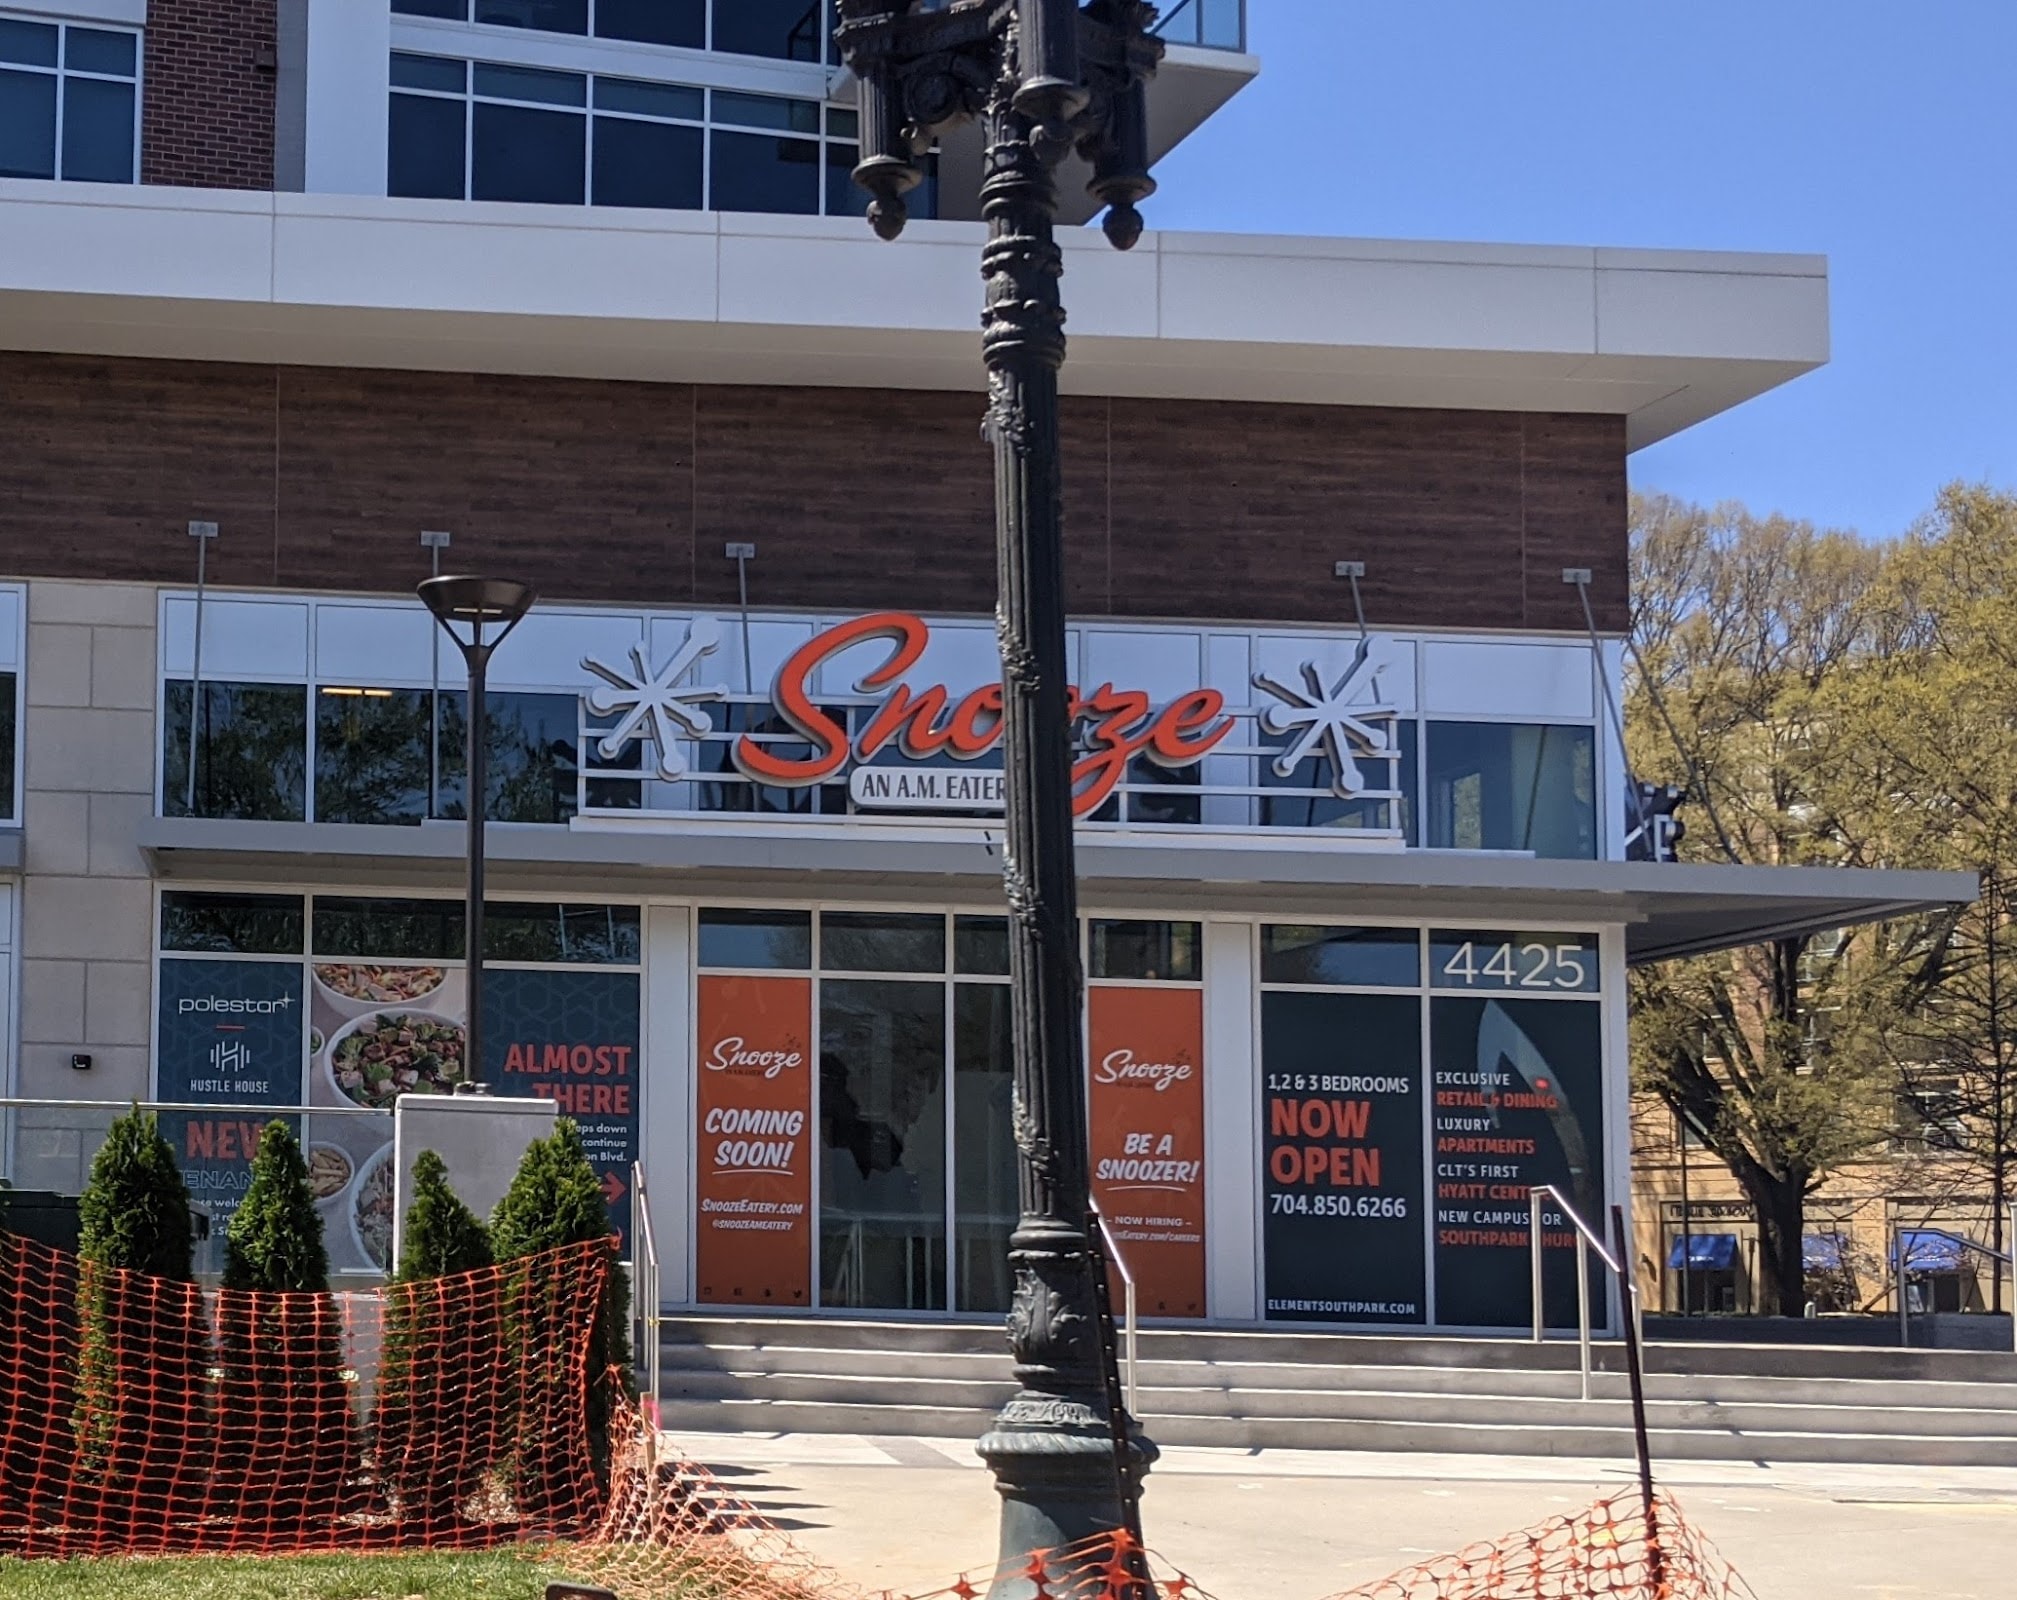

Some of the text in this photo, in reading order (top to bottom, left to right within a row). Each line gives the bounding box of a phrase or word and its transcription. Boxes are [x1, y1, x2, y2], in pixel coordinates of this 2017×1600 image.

[735, 612, 1235, 818] Snoze
[862, 774, 1006, 800] AN A.M. EATER
[1443, 941, 1584, 988] 4425
[179, 994, 288, 1014] polestar
[504, 1043, 631, 1075] ALMOST
[705, 1037, 802, 1079] Snooze
[1095, 1049, 1192, 1091] Snooze
[1436, 1072, 1511, 1086] EXCLUSIVE
[190, 1079, 269, 1094] HUSTLE HOUSE
[1268, 1074, 1409, 1093] 1,2 & 3 BEDROOMS
[532, 1083, 630, 1115] THERE
[1436, 1091, 1487, 1107] RETAIL
[1503, 1093, 1558, 1109] DINING
[705, 1108, 804, 1136] COMING
[1271, 1098, 1370, 1138] NOW
[1437, 1118, 1490, 1132] LUXURY
[575, 1123, 627, 1135] eps down
[582, 1137, 627, 1147] continue
[1124, 1133, 1173, 1156] BE A
[1438, 1138, 1535, 1155] APARTMENTS
[600, 1151, 627, 1161] Blvd.
[714, 1140, 794, 1168] SOON!
[1096, 1159, 1200, 1182] SNOOZER!
[1270, 1145, 1380, 1186] OPEN
[1437, 1164, 1519, 1178] CLT'S FIRST
[1438, 1184, 1486, 1199] HYATT
[1270, 1194, 1406, 1217] 704.850.6266
[1114, 1216, 1183, 1226] NOW HIRING
[1438, 1210, 1468, 1223] NEW
[1473, 1211, 1529, 1225] CAMPUS
[1439, 1230, 1529, 1246] SOUTHPARK
[1268, 1299, 1416, 1315] ELEMENTSOUTHPARK.COM
